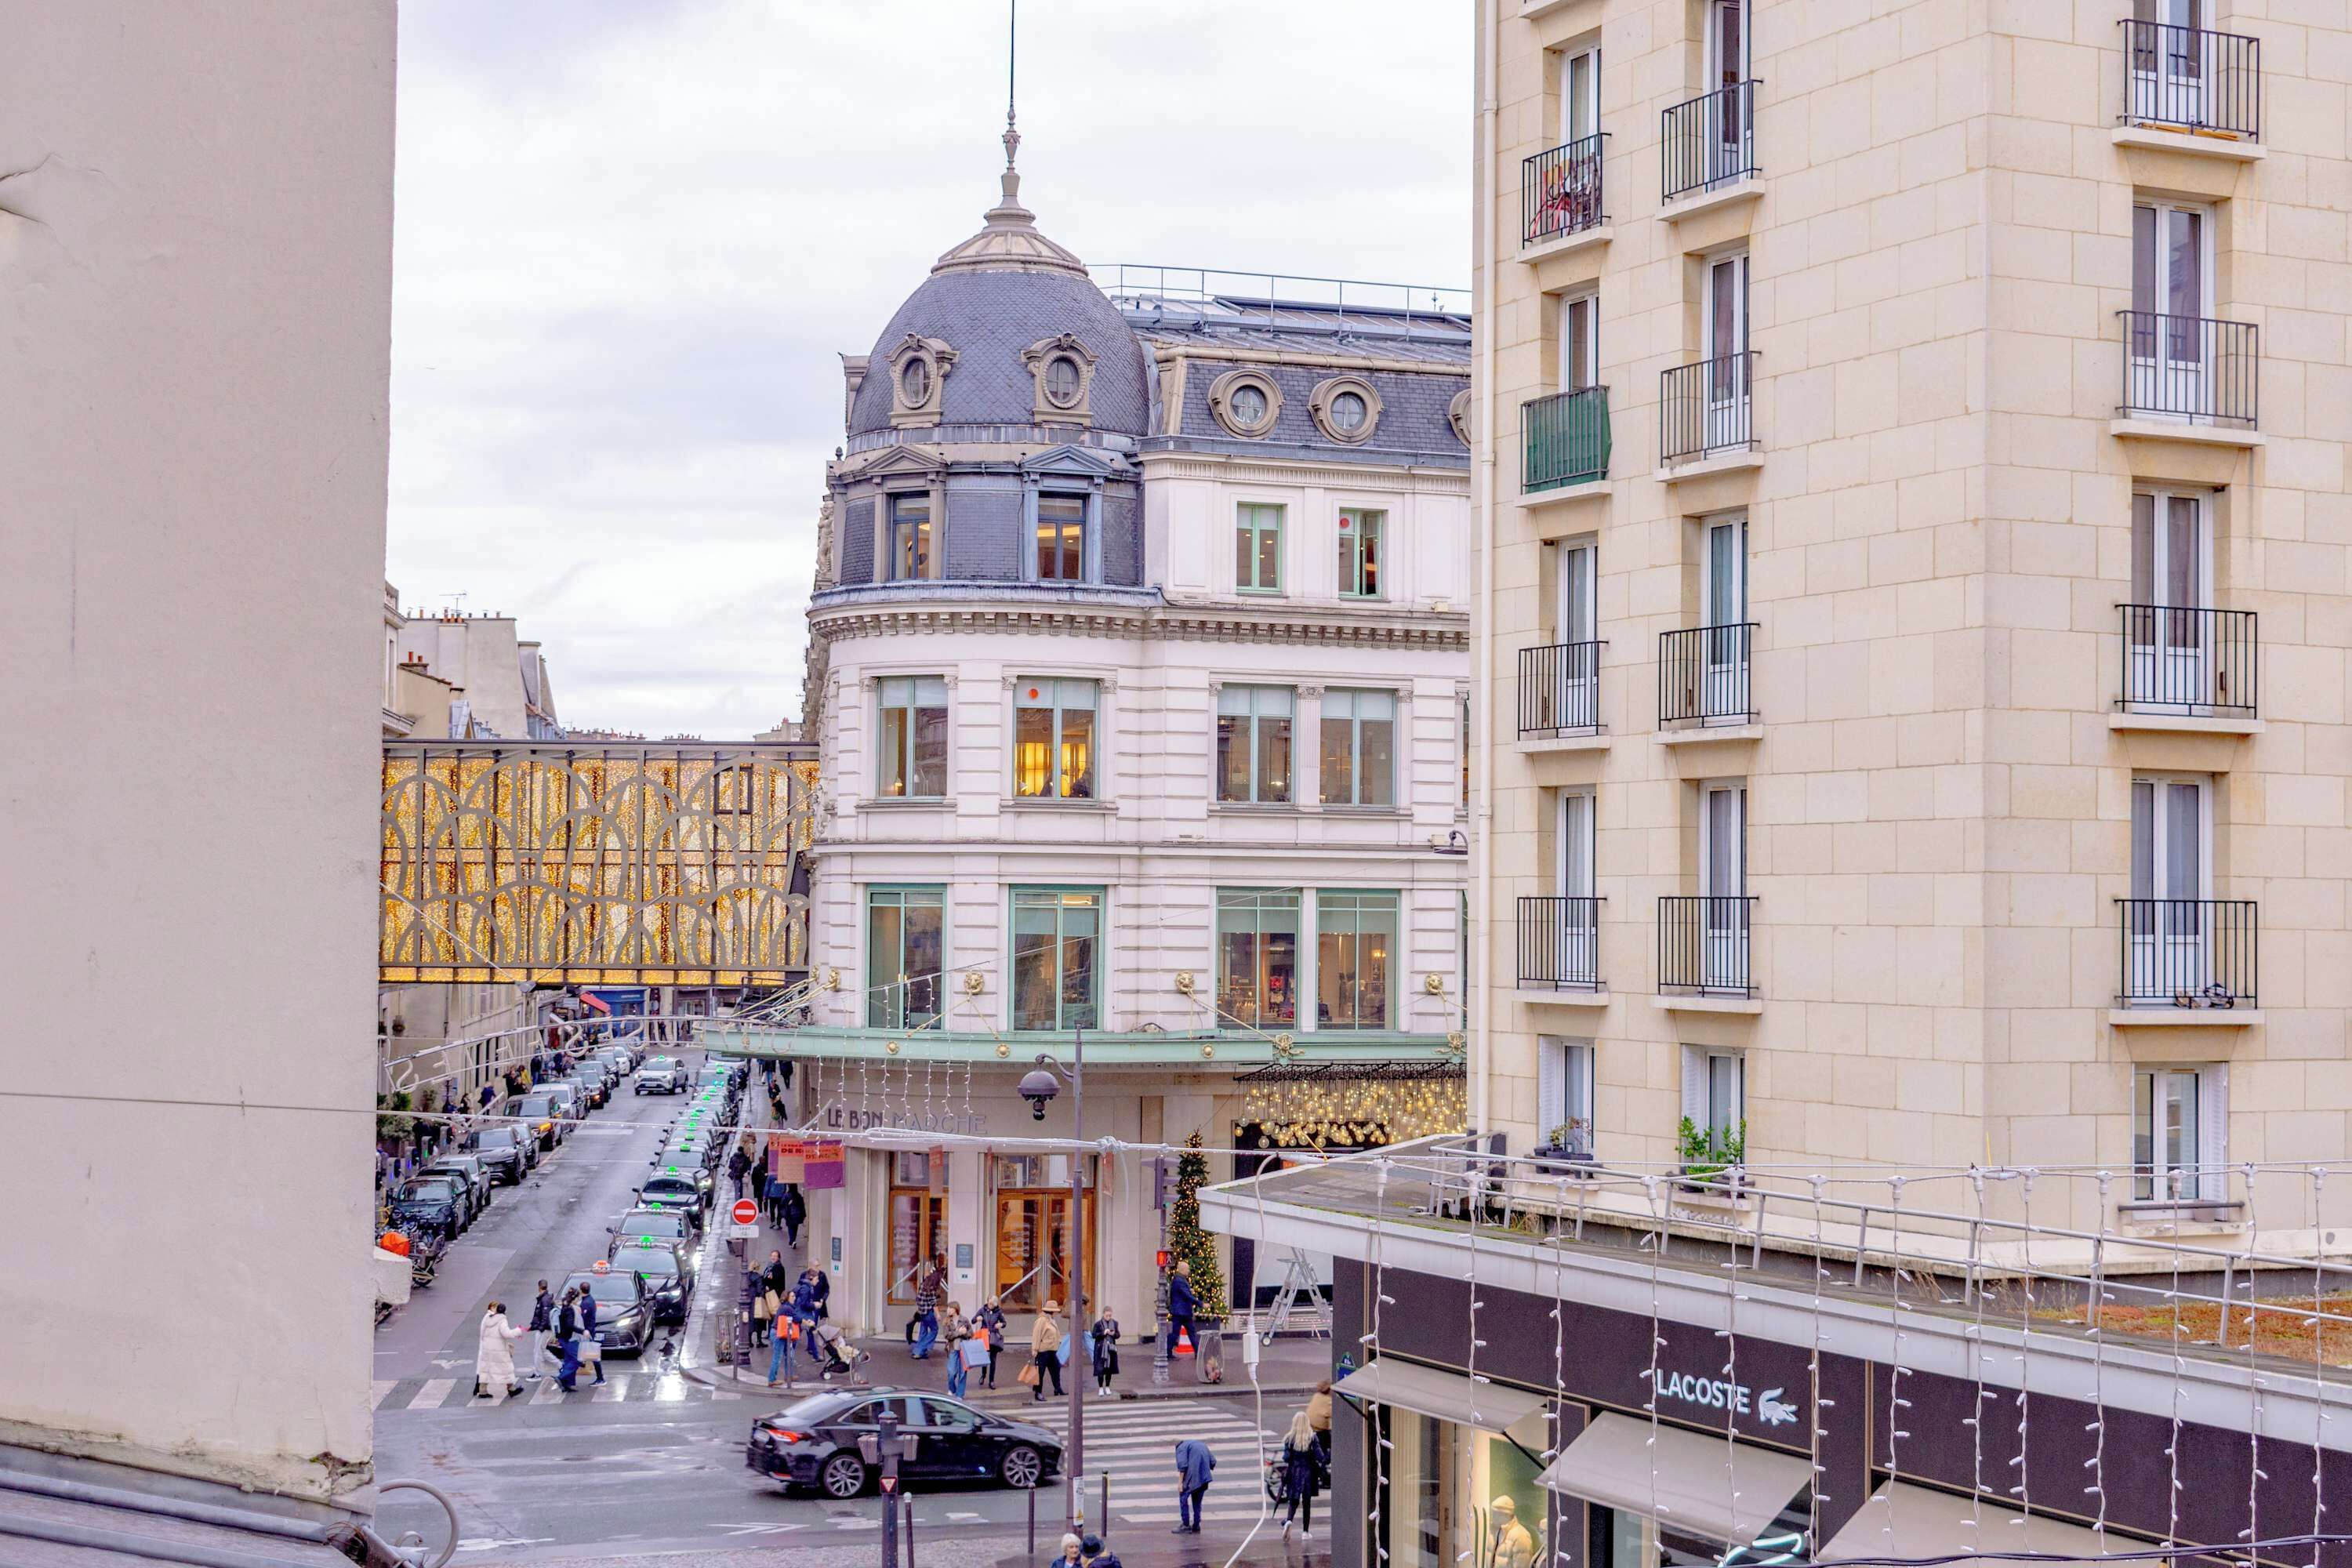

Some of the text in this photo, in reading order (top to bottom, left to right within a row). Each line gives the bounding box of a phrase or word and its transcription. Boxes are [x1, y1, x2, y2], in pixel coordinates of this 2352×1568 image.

[828, 1108, 844, 1127] LE
[849, 1109, 884, 1130] BON
[1655, 1368, 1751, 1414] LACOSTE
